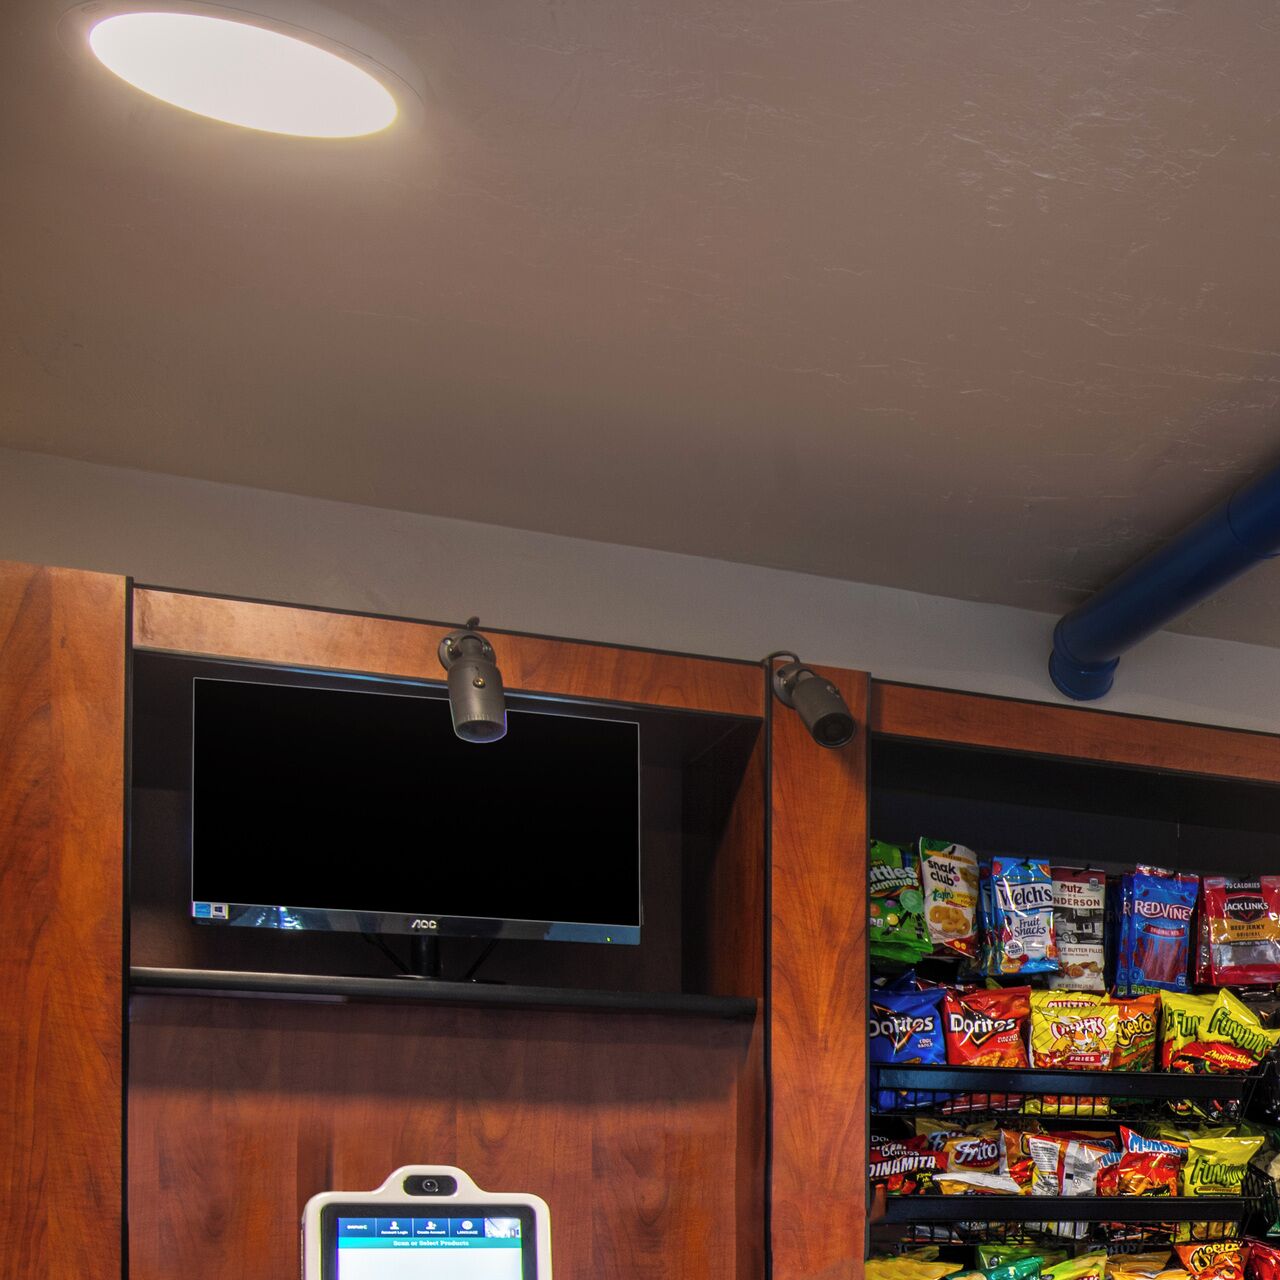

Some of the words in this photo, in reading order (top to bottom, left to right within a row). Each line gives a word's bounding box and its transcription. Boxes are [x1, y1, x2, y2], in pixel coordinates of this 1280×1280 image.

[928, 859, 957, 875] snak
[930, 872, 955, 888] club
[998, 886, 1053, 908] Welch's
[1224, 902, 1243, 912] JACK
[411, 918, 437, 930] AOC
[1018, 917, 1040, 928] Fruit
[1014, 924, 1047, 937] Snacks
[949, 1013, 1017, 1034] Doritos
[1069, 1055, 1095, 1063] FRIES
